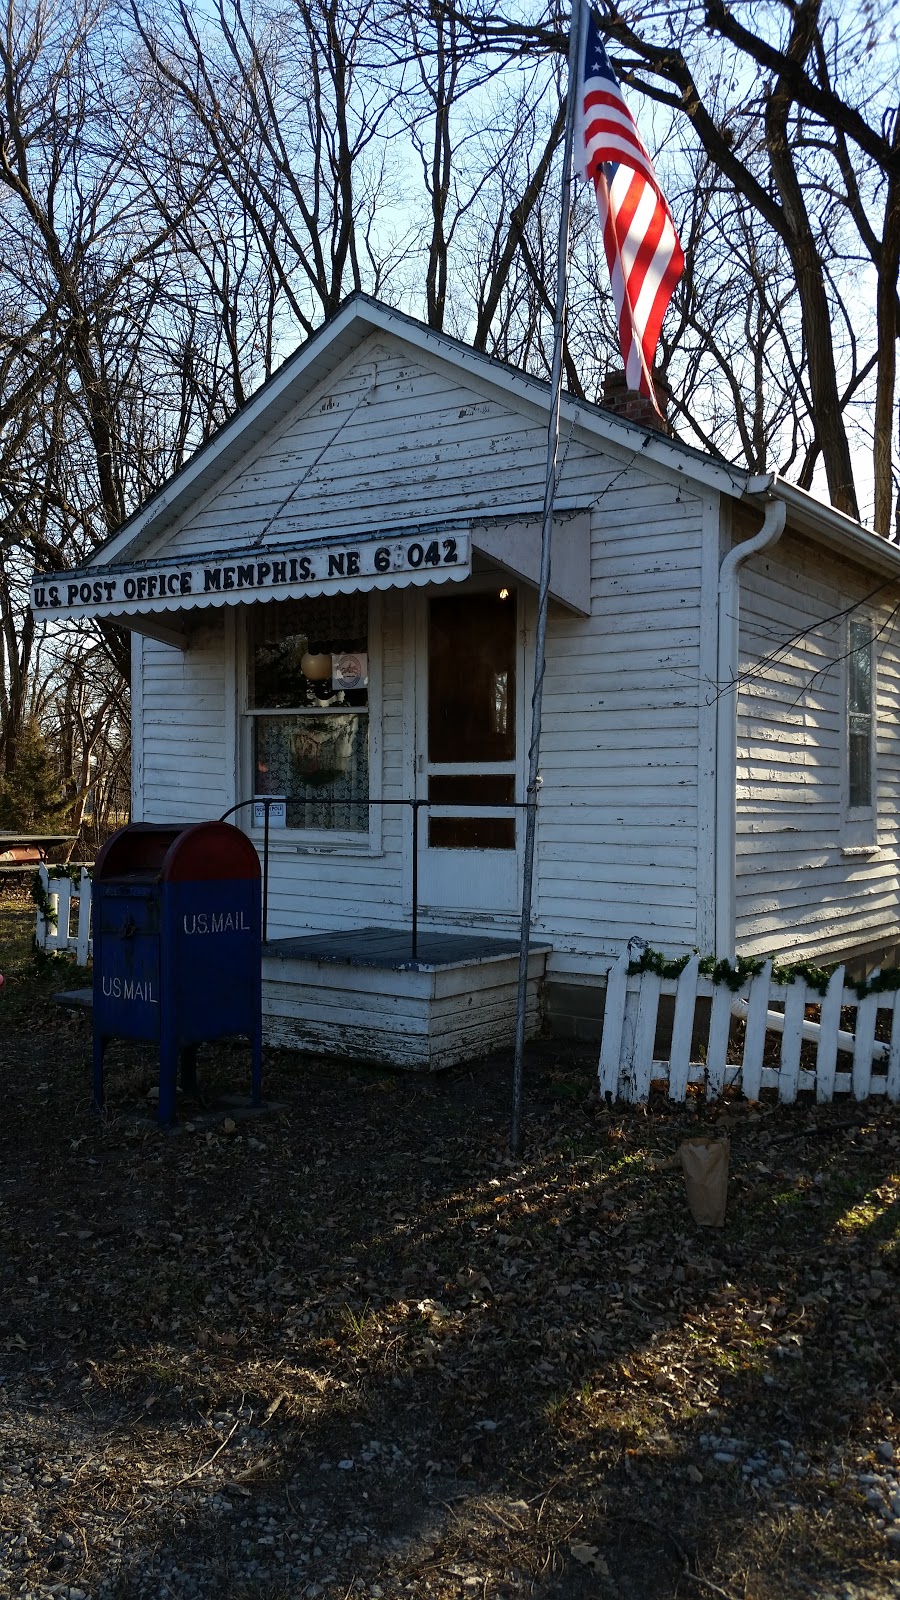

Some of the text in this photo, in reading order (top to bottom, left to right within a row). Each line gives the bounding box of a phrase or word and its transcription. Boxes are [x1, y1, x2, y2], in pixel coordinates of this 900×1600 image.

[33, 586, 62, 608] U.S.
[67, 580, 116, 605] POST
[123, 571, 192, 599] OFFICE
[327, 551, 360, 577] NE
[211, 911, 251, 933] MAIL
[123, 978, 158, 1003] MAIL
